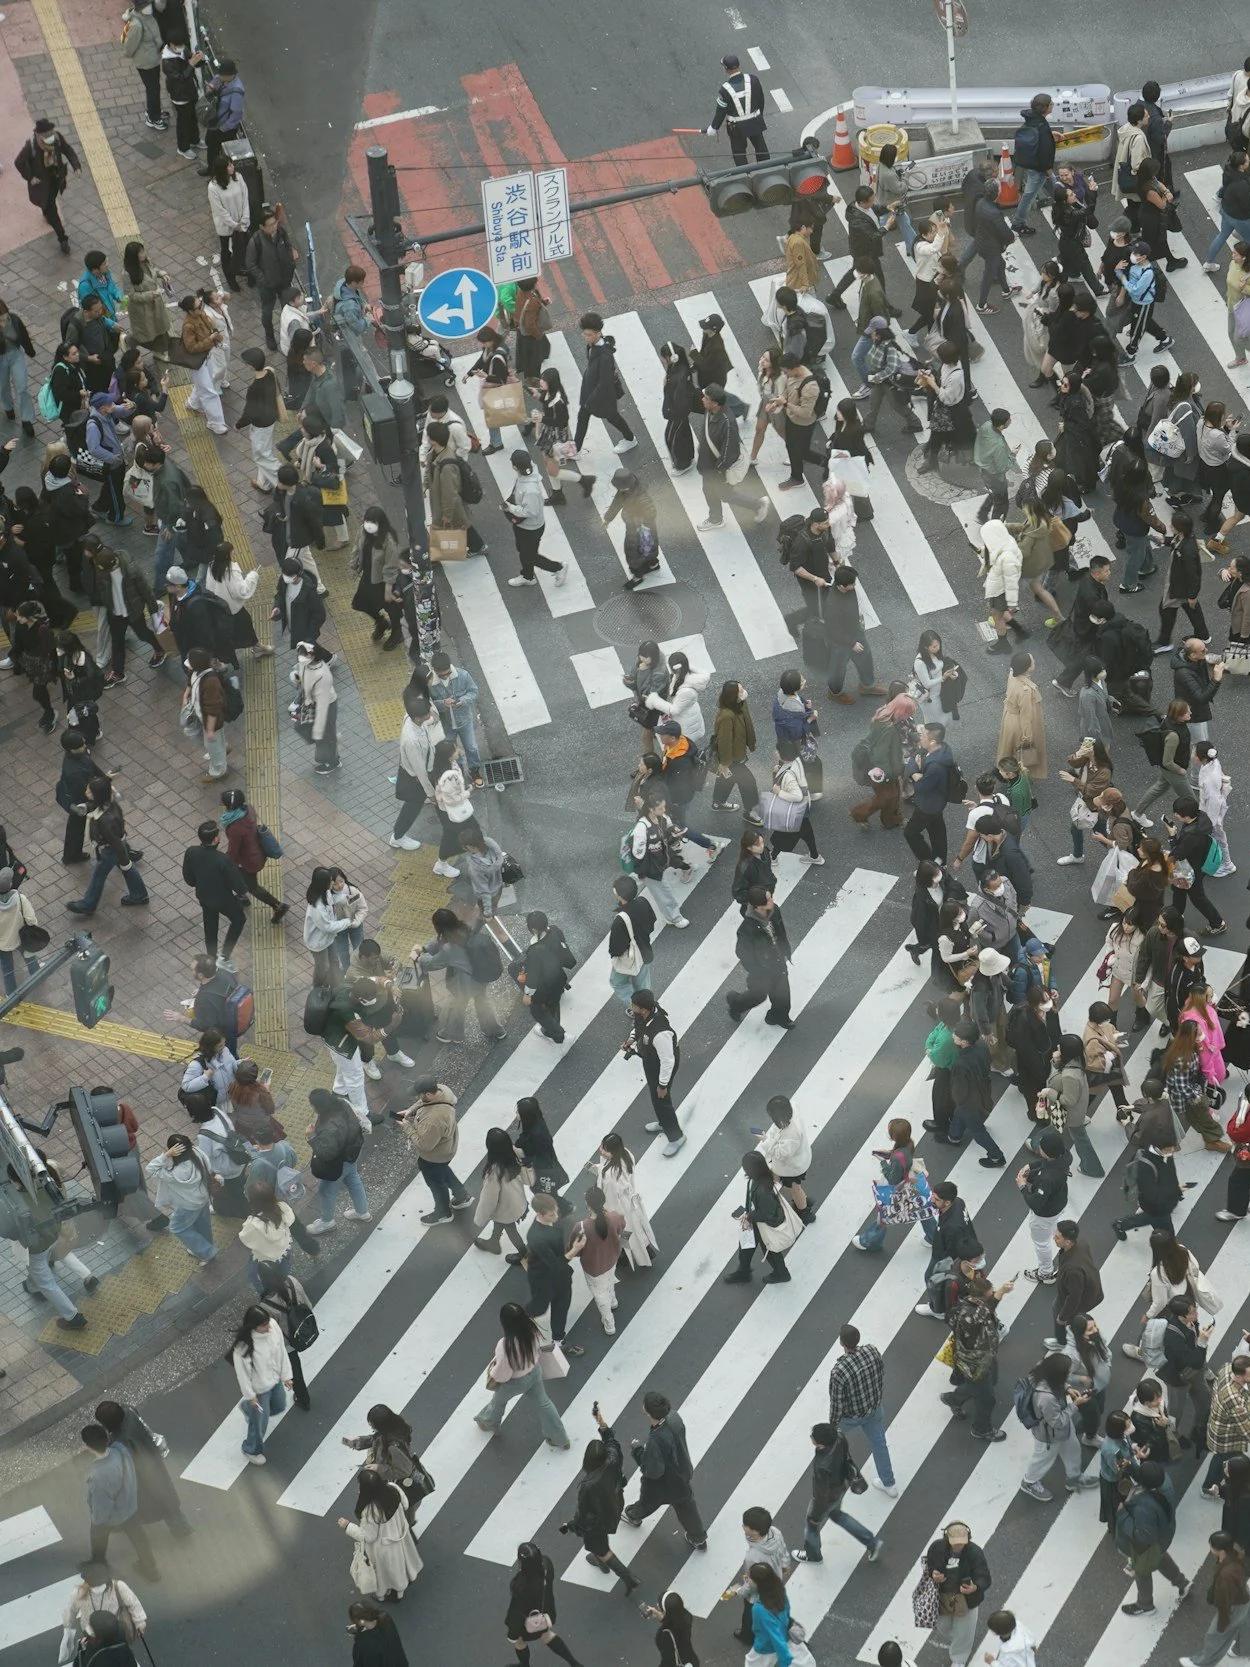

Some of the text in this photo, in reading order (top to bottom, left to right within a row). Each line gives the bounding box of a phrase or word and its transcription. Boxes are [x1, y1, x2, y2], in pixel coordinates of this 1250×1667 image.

[491, 201, 507, 267] Shibuya Sta.
[505, 184, 532, 273] 渋谷駅前
